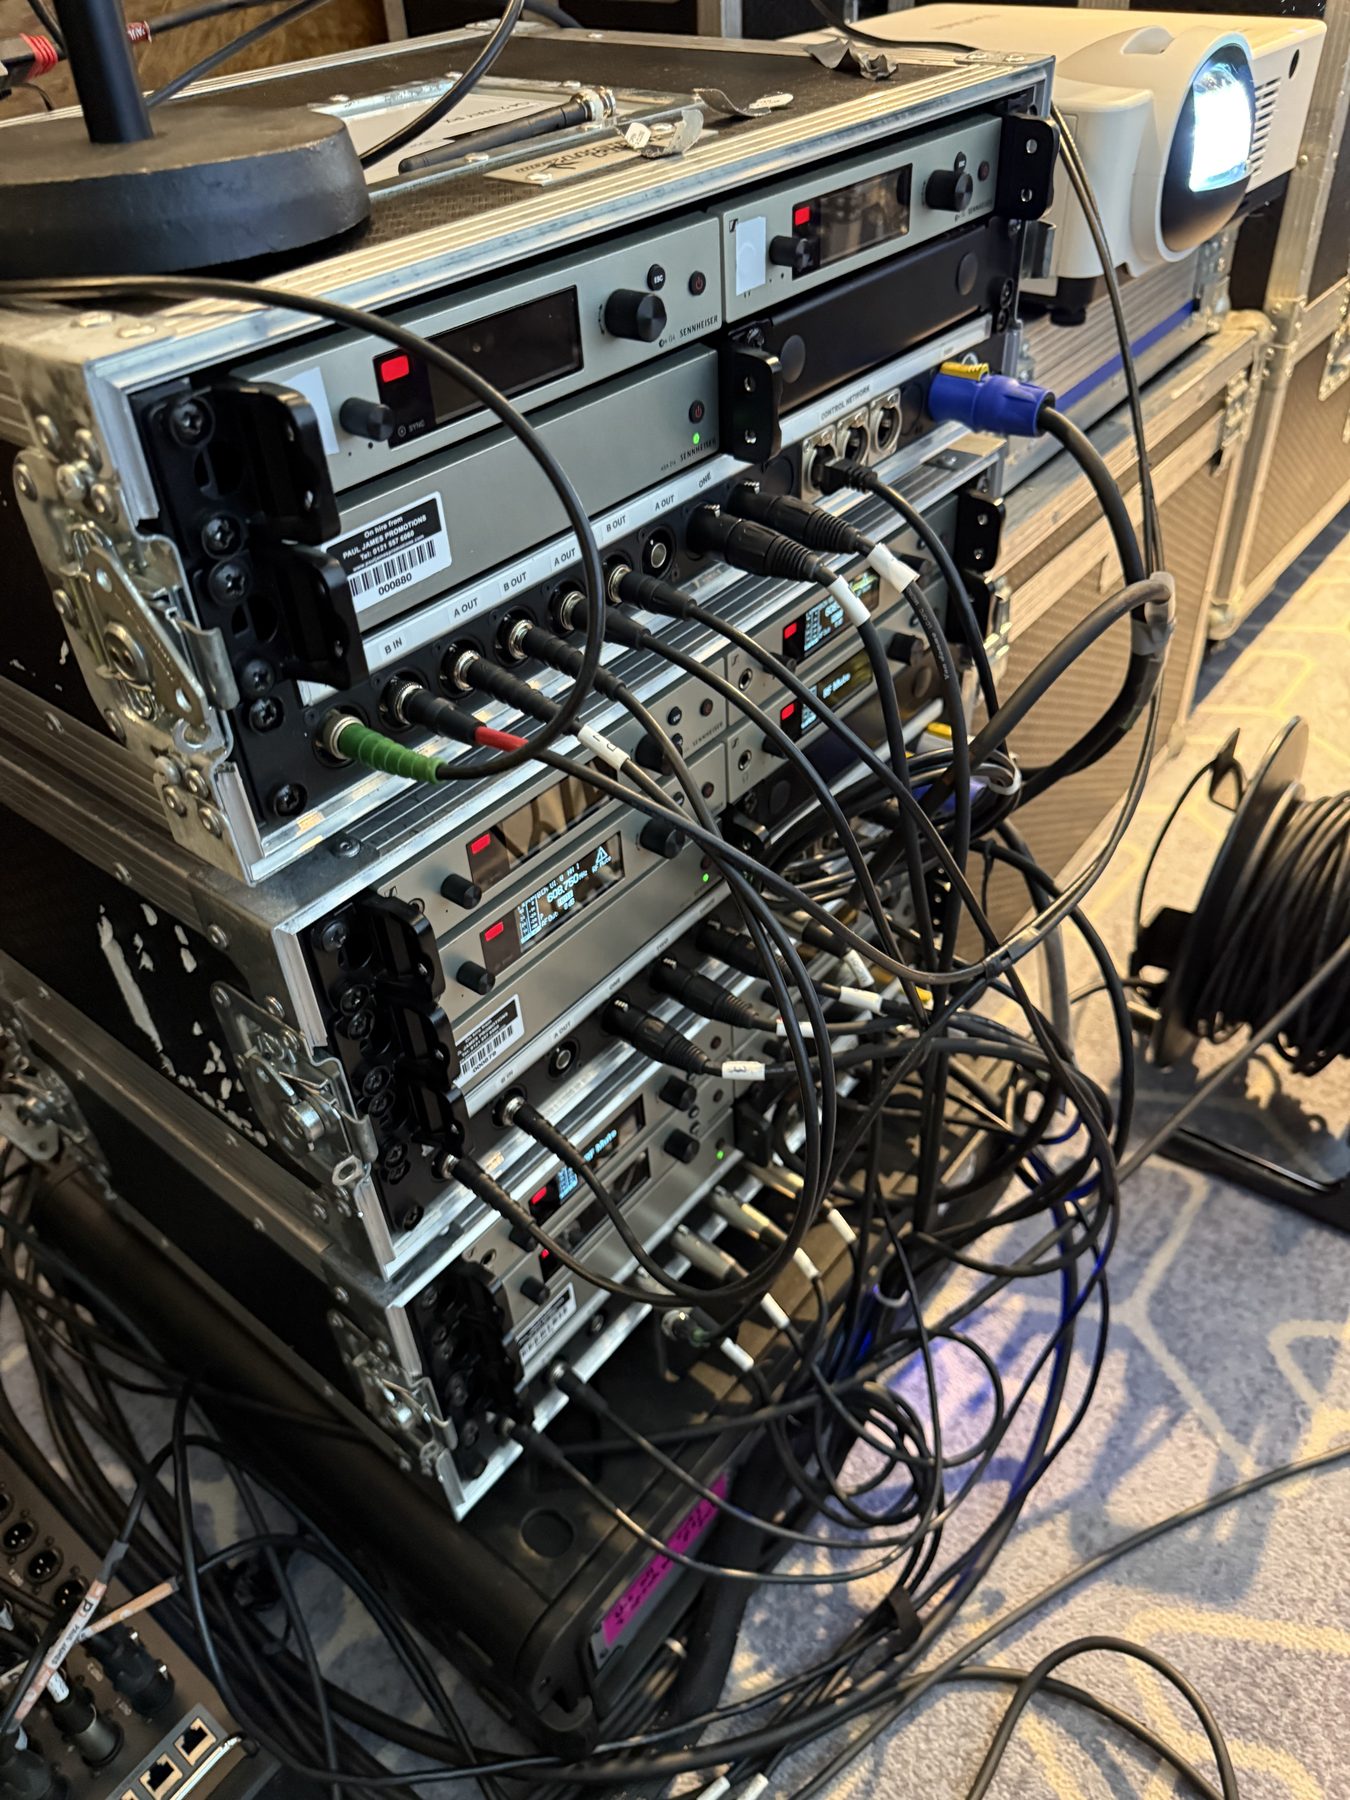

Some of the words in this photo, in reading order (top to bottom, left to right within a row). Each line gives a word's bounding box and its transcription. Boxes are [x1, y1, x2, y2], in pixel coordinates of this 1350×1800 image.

[679, 314, 718, 338] SENNHEISER
[820, 401, 845, 422] CONTROL
[846, 383, 871, 406] NETWORK
[698, 472, 712, 489] ONE
[661, 495, 675, 509] OUT
[364, 529, 374, 538] On
[374, 522, 388, 534] hire
[388, 516, 404, 528] from
[612, 515, 627, 530] OUT
[342, 546, 361, 560] PAUL
[361, 535, 384, 550] JAMES
[384, 514, 427, 540] PROMOTIONS
[372, 544, 388, 555] 0121
[554, 556, 560, 567] A
[560, 548, 576, 563] OUT
[378, 573, 412, 595] 000880
[503, 582, 510, 592] B
[511, 571, 527, 588] OUT
[454, 608, 460, 618] A
[461, 598, 479, 613] OUT
[384, 644, 391, 655] B
[392, 637, 404, 651] IN
[558, 1020, 571, 1034] OUT
